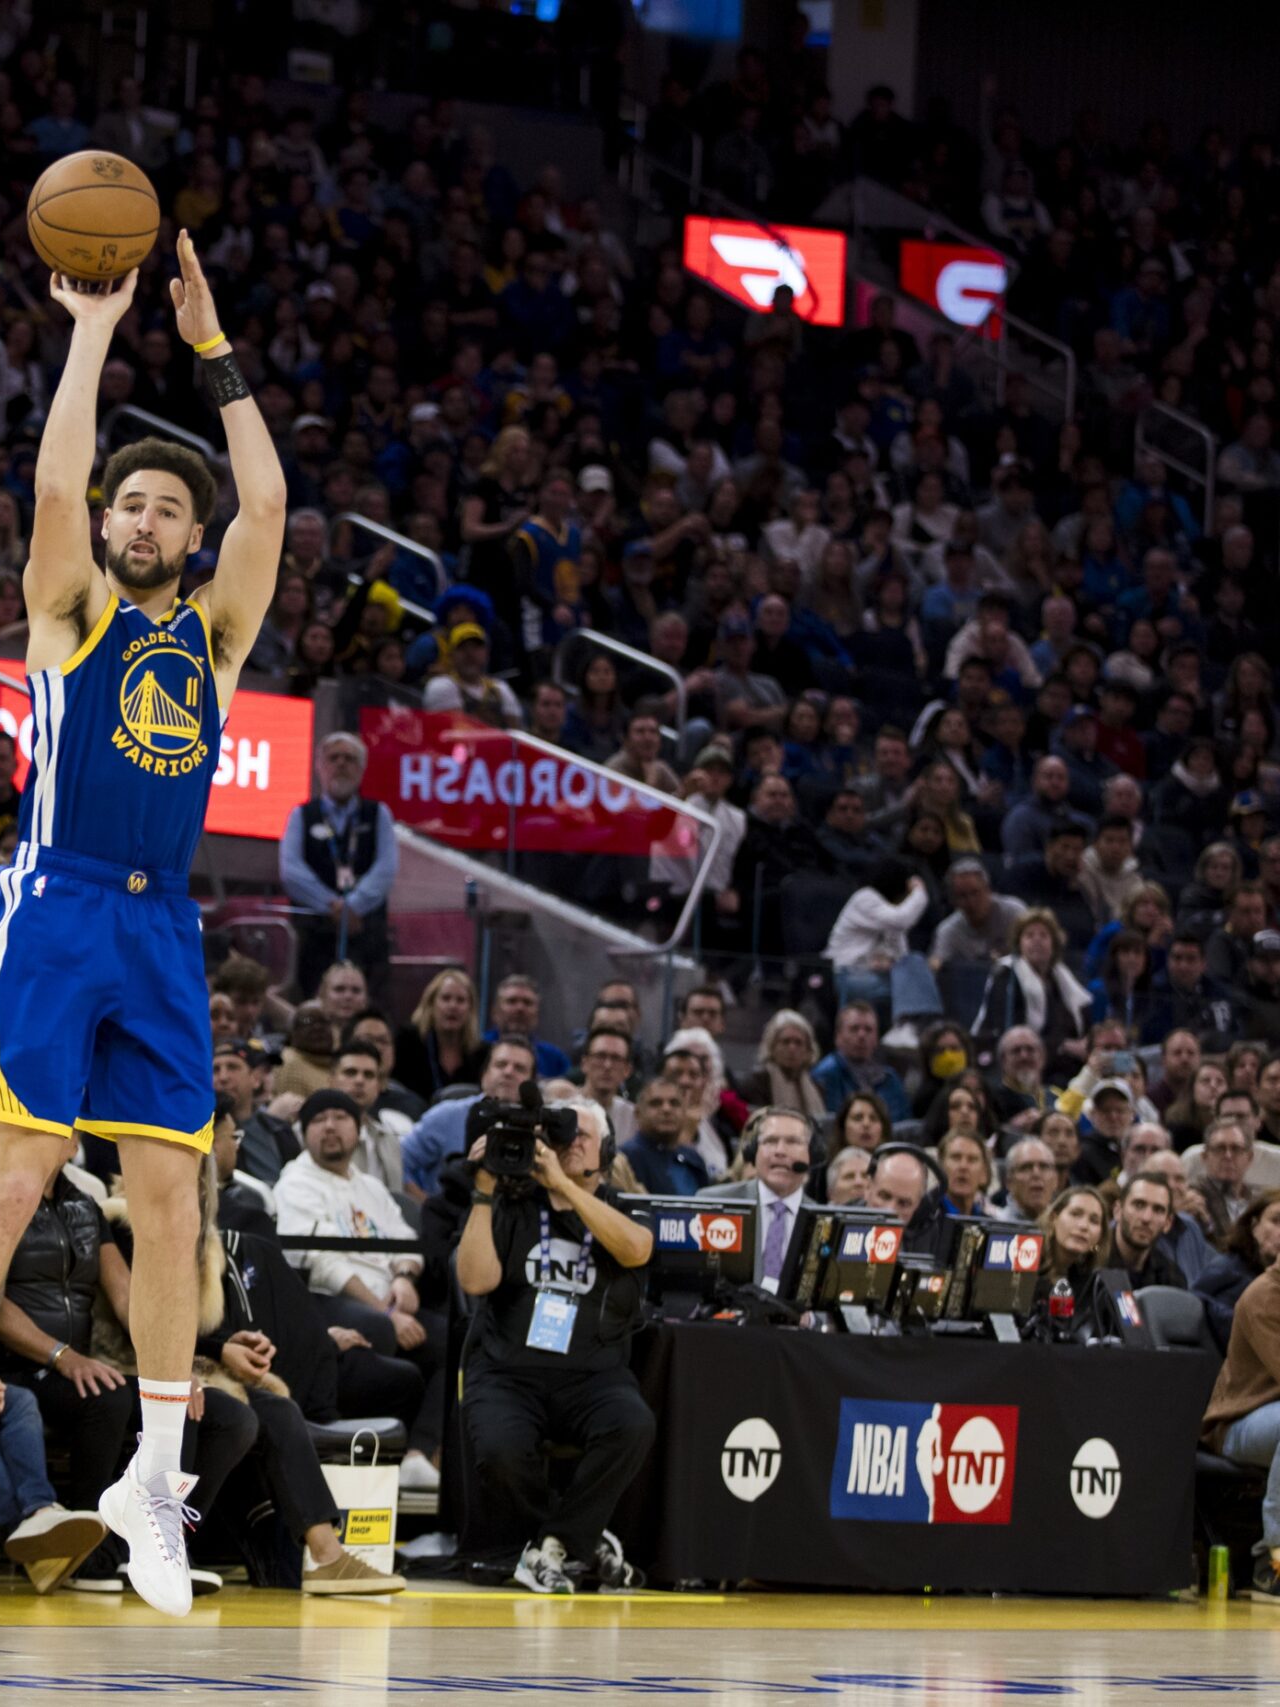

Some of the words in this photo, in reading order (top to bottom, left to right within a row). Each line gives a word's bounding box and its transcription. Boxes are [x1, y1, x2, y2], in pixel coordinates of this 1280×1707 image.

[186, 676, 198, 707] 11
[111, 726, 208, 777] WARRIORS
[659, 1219, 686, 1243] NBA
[708, 1227, 736, 1241] TNT
[843, 1232, 864, 1255] NBA
[875, 1240, 896, 1252] TNT
[721, 1447, 782, 1478] TNT
[847, 1423, 908, 1497] NBA
[948, 1450, 1005, 1486] TNT
[1071, 1465, 1120, 1496] TNT
[351, 1514, 389, 1522] WARRIORS
